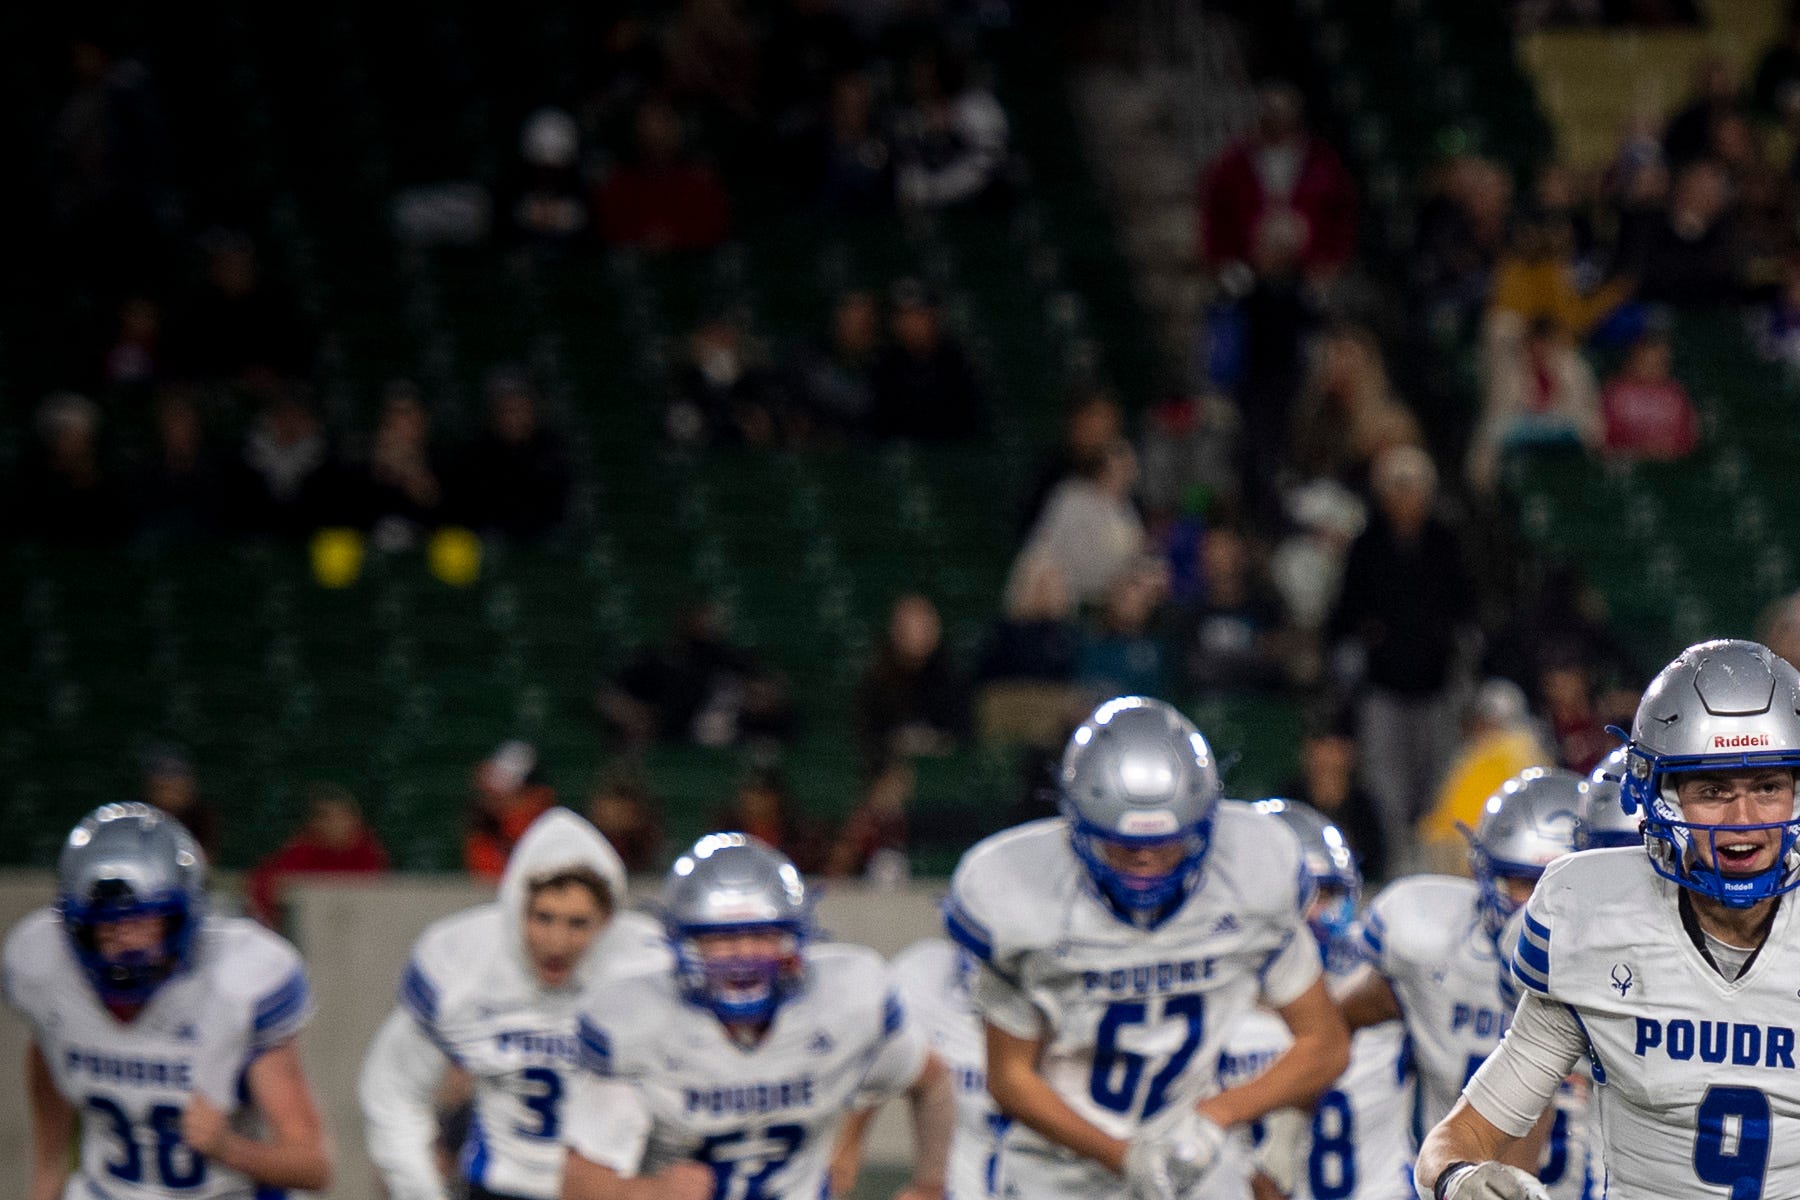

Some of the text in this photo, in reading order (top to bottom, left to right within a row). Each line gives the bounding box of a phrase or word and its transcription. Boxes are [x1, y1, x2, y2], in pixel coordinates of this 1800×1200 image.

[1714, 735, 1769, 748] Riddell
[1725, 882, 1754, 891] Riddell
[1083, 956, 1216, 993] POUDRE
